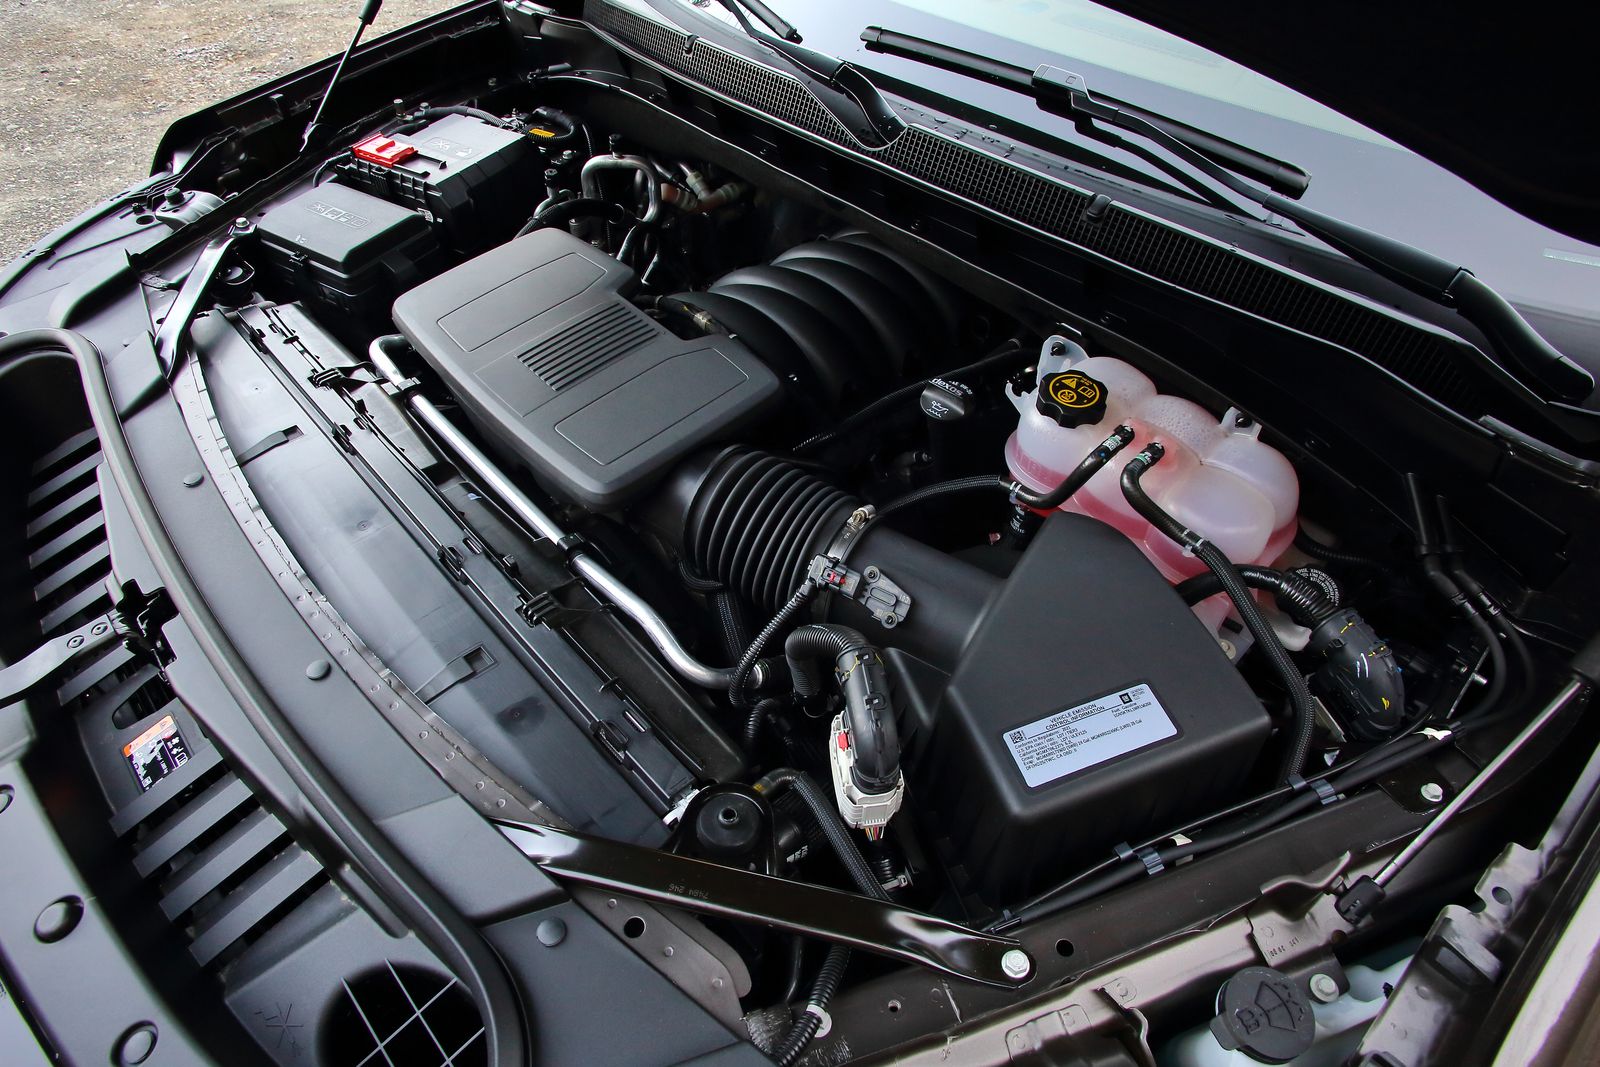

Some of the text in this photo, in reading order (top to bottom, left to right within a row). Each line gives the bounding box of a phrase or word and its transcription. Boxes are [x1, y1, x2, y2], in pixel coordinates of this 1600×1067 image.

[932, 378, 964, 396] dexos
[1045, 706, 1105, 730] CONTROL INFORMATION
[1050, 704, 1097, 723] VEHICLE EMISSION
[1015, 740, 1033, 749] Conforms
[1019, 748, 1038, 757] California
